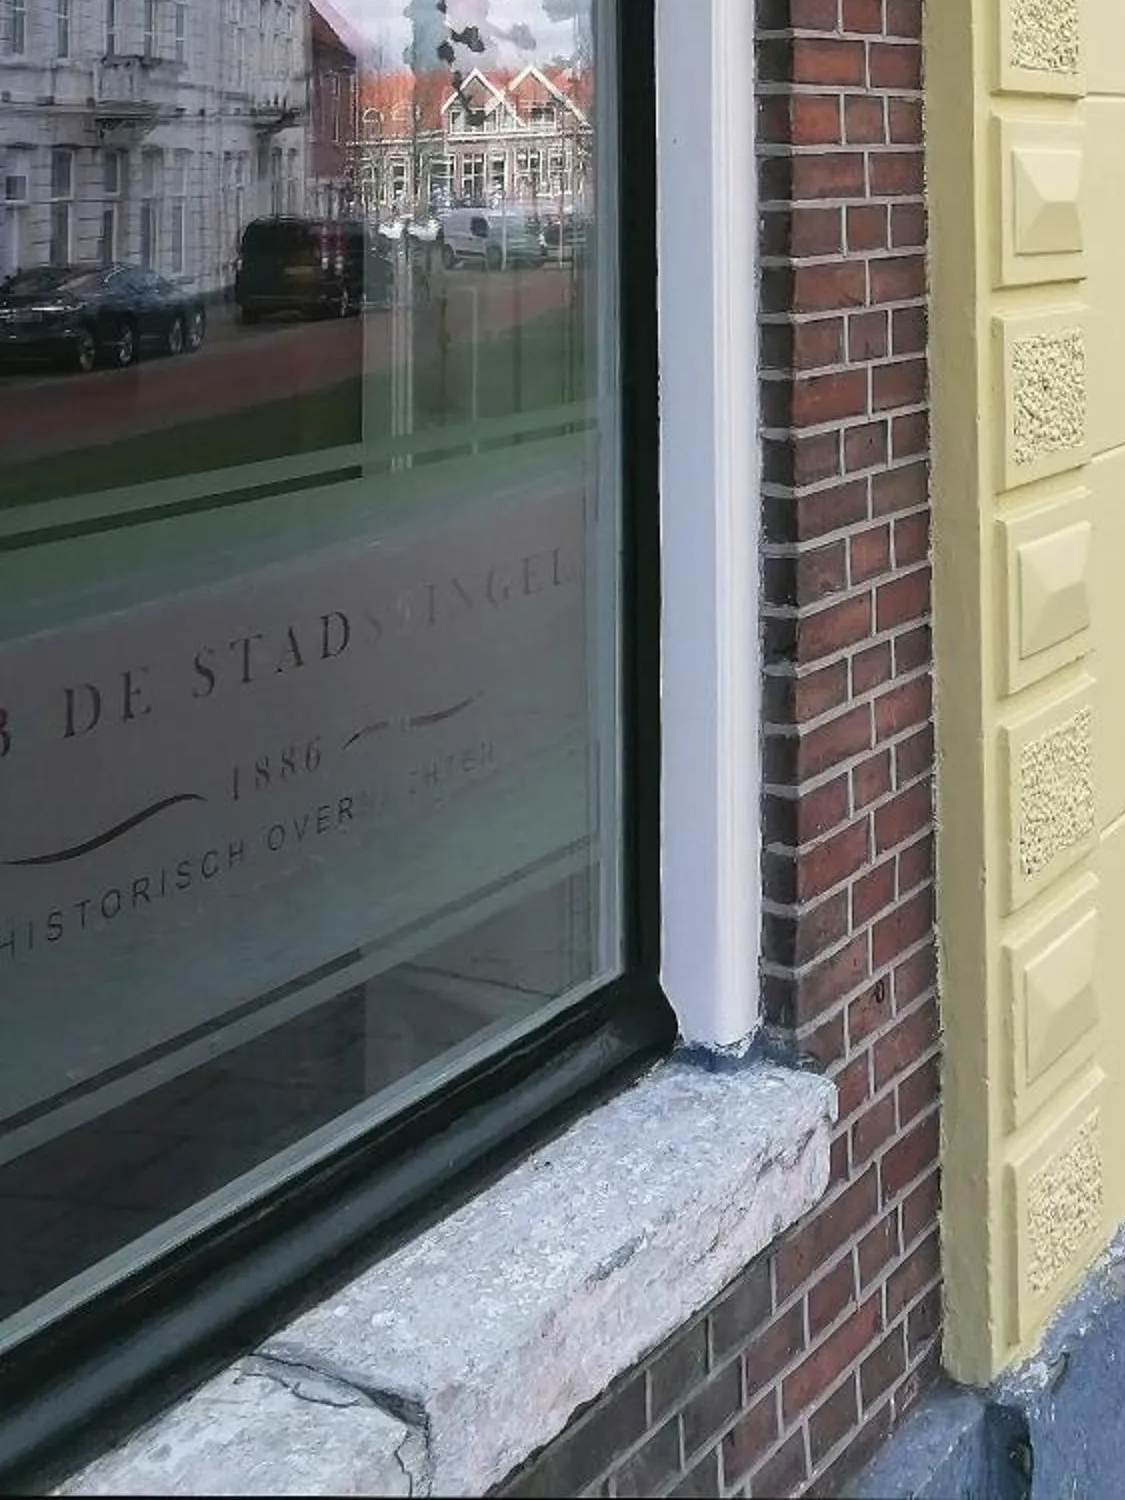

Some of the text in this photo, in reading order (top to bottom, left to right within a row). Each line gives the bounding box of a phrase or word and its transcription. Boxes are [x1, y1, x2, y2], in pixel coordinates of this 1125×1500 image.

[62, 666, 152, 740] DE
[232, 735, 323, 801] 1886
[0, 841, 244, 959] HISTORISCH
